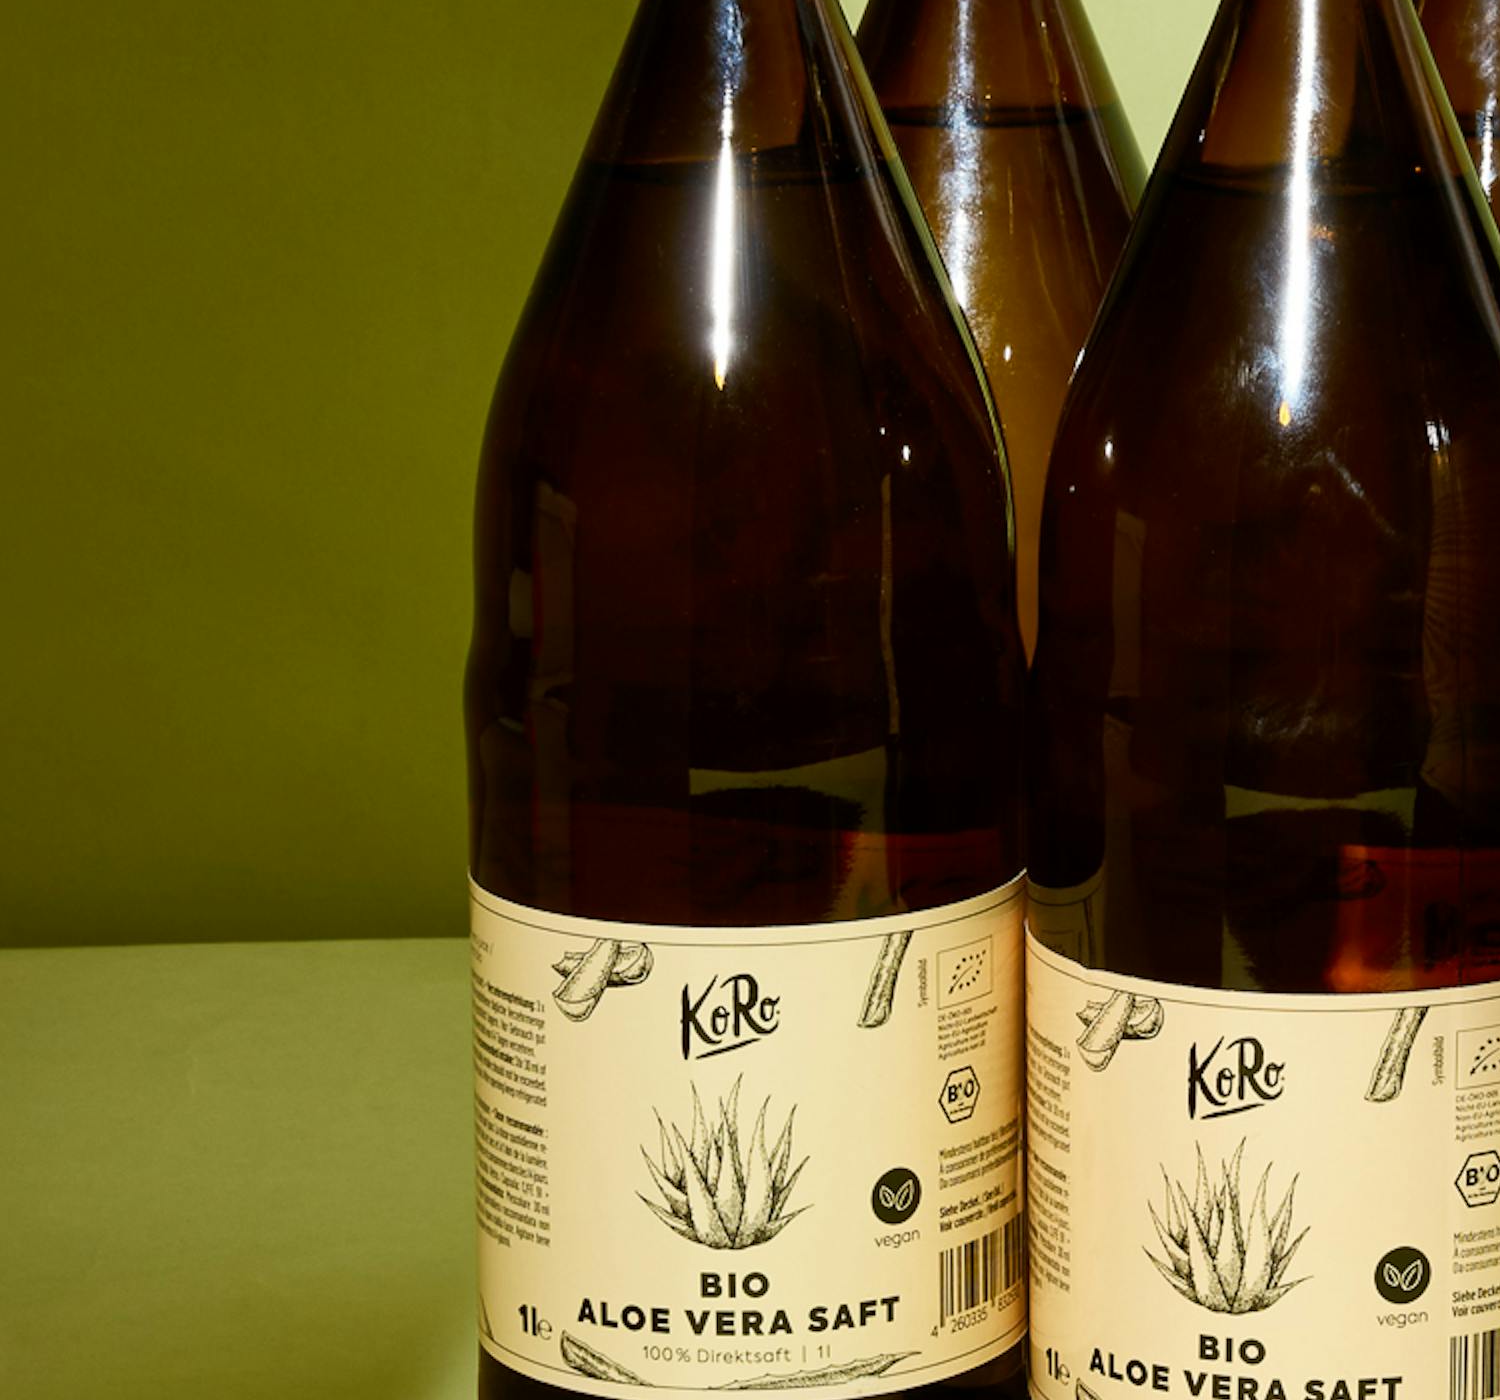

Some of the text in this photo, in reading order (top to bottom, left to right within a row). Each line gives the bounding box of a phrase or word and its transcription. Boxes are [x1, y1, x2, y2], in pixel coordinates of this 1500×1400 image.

[680, 974, 780, 1060] KoRo
[1432, 1035, 1445, 1087] Symbolbild
[1188, 1036, 1285, 1120] KoRo
[874, 1229, 921, 1248] vegan
[700, 1272, 771, 1299] BIO
[1452, 1289, 1476, 1304] Siehe
[577, 1296, 901, 1337] ALOE VERA SAFT
[930, 1307, 989, 1337] 4 260335
[1376, 1310, 1429, 1329] vegan
[697, 1347, 792, 1364] Direktsaft
[1199, 1334, 1266, 1365] BIO
[1089, 1348, 1170, 1393] ALOE
